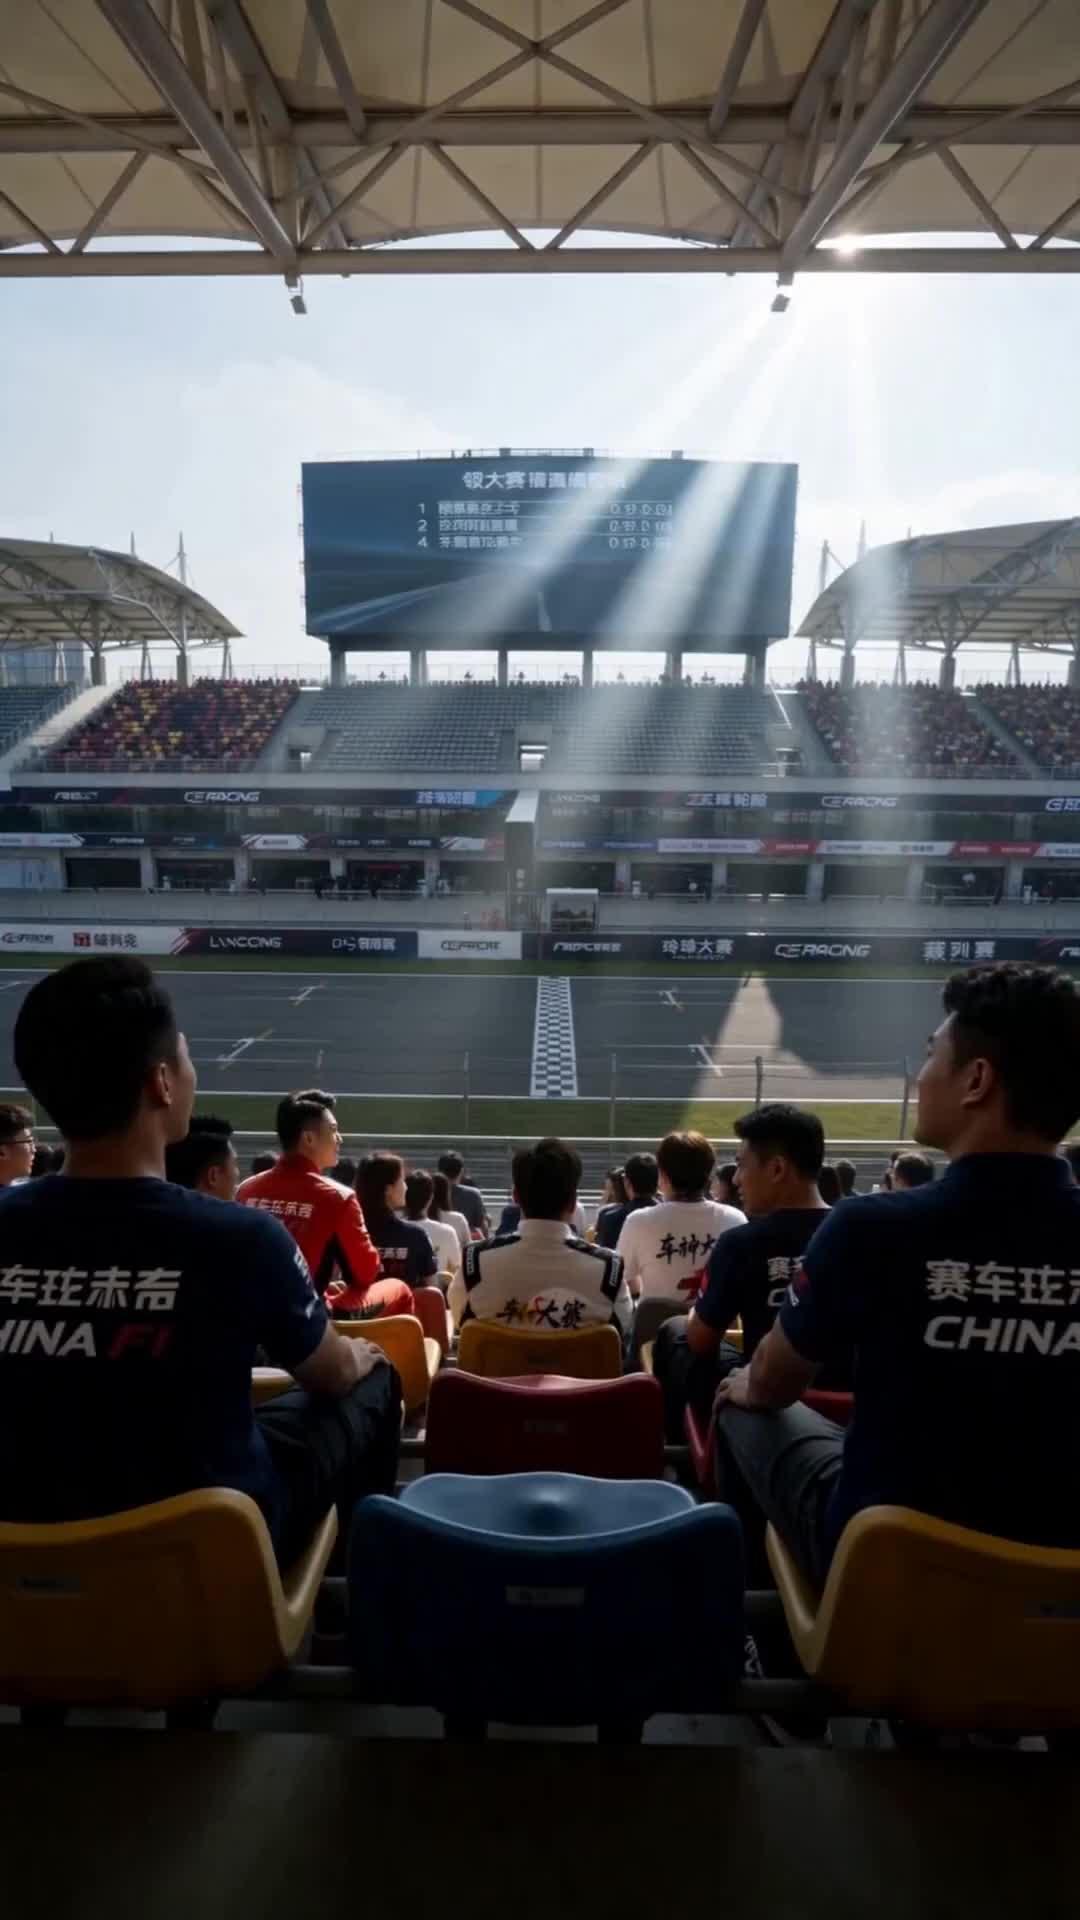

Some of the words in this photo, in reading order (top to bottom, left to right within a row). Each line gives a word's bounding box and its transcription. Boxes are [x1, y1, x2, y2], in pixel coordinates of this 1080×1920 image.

[417, 503, 425, 514] 1
[418, 519, 428, 533] 2
[417, 536, 428, 548] 4
